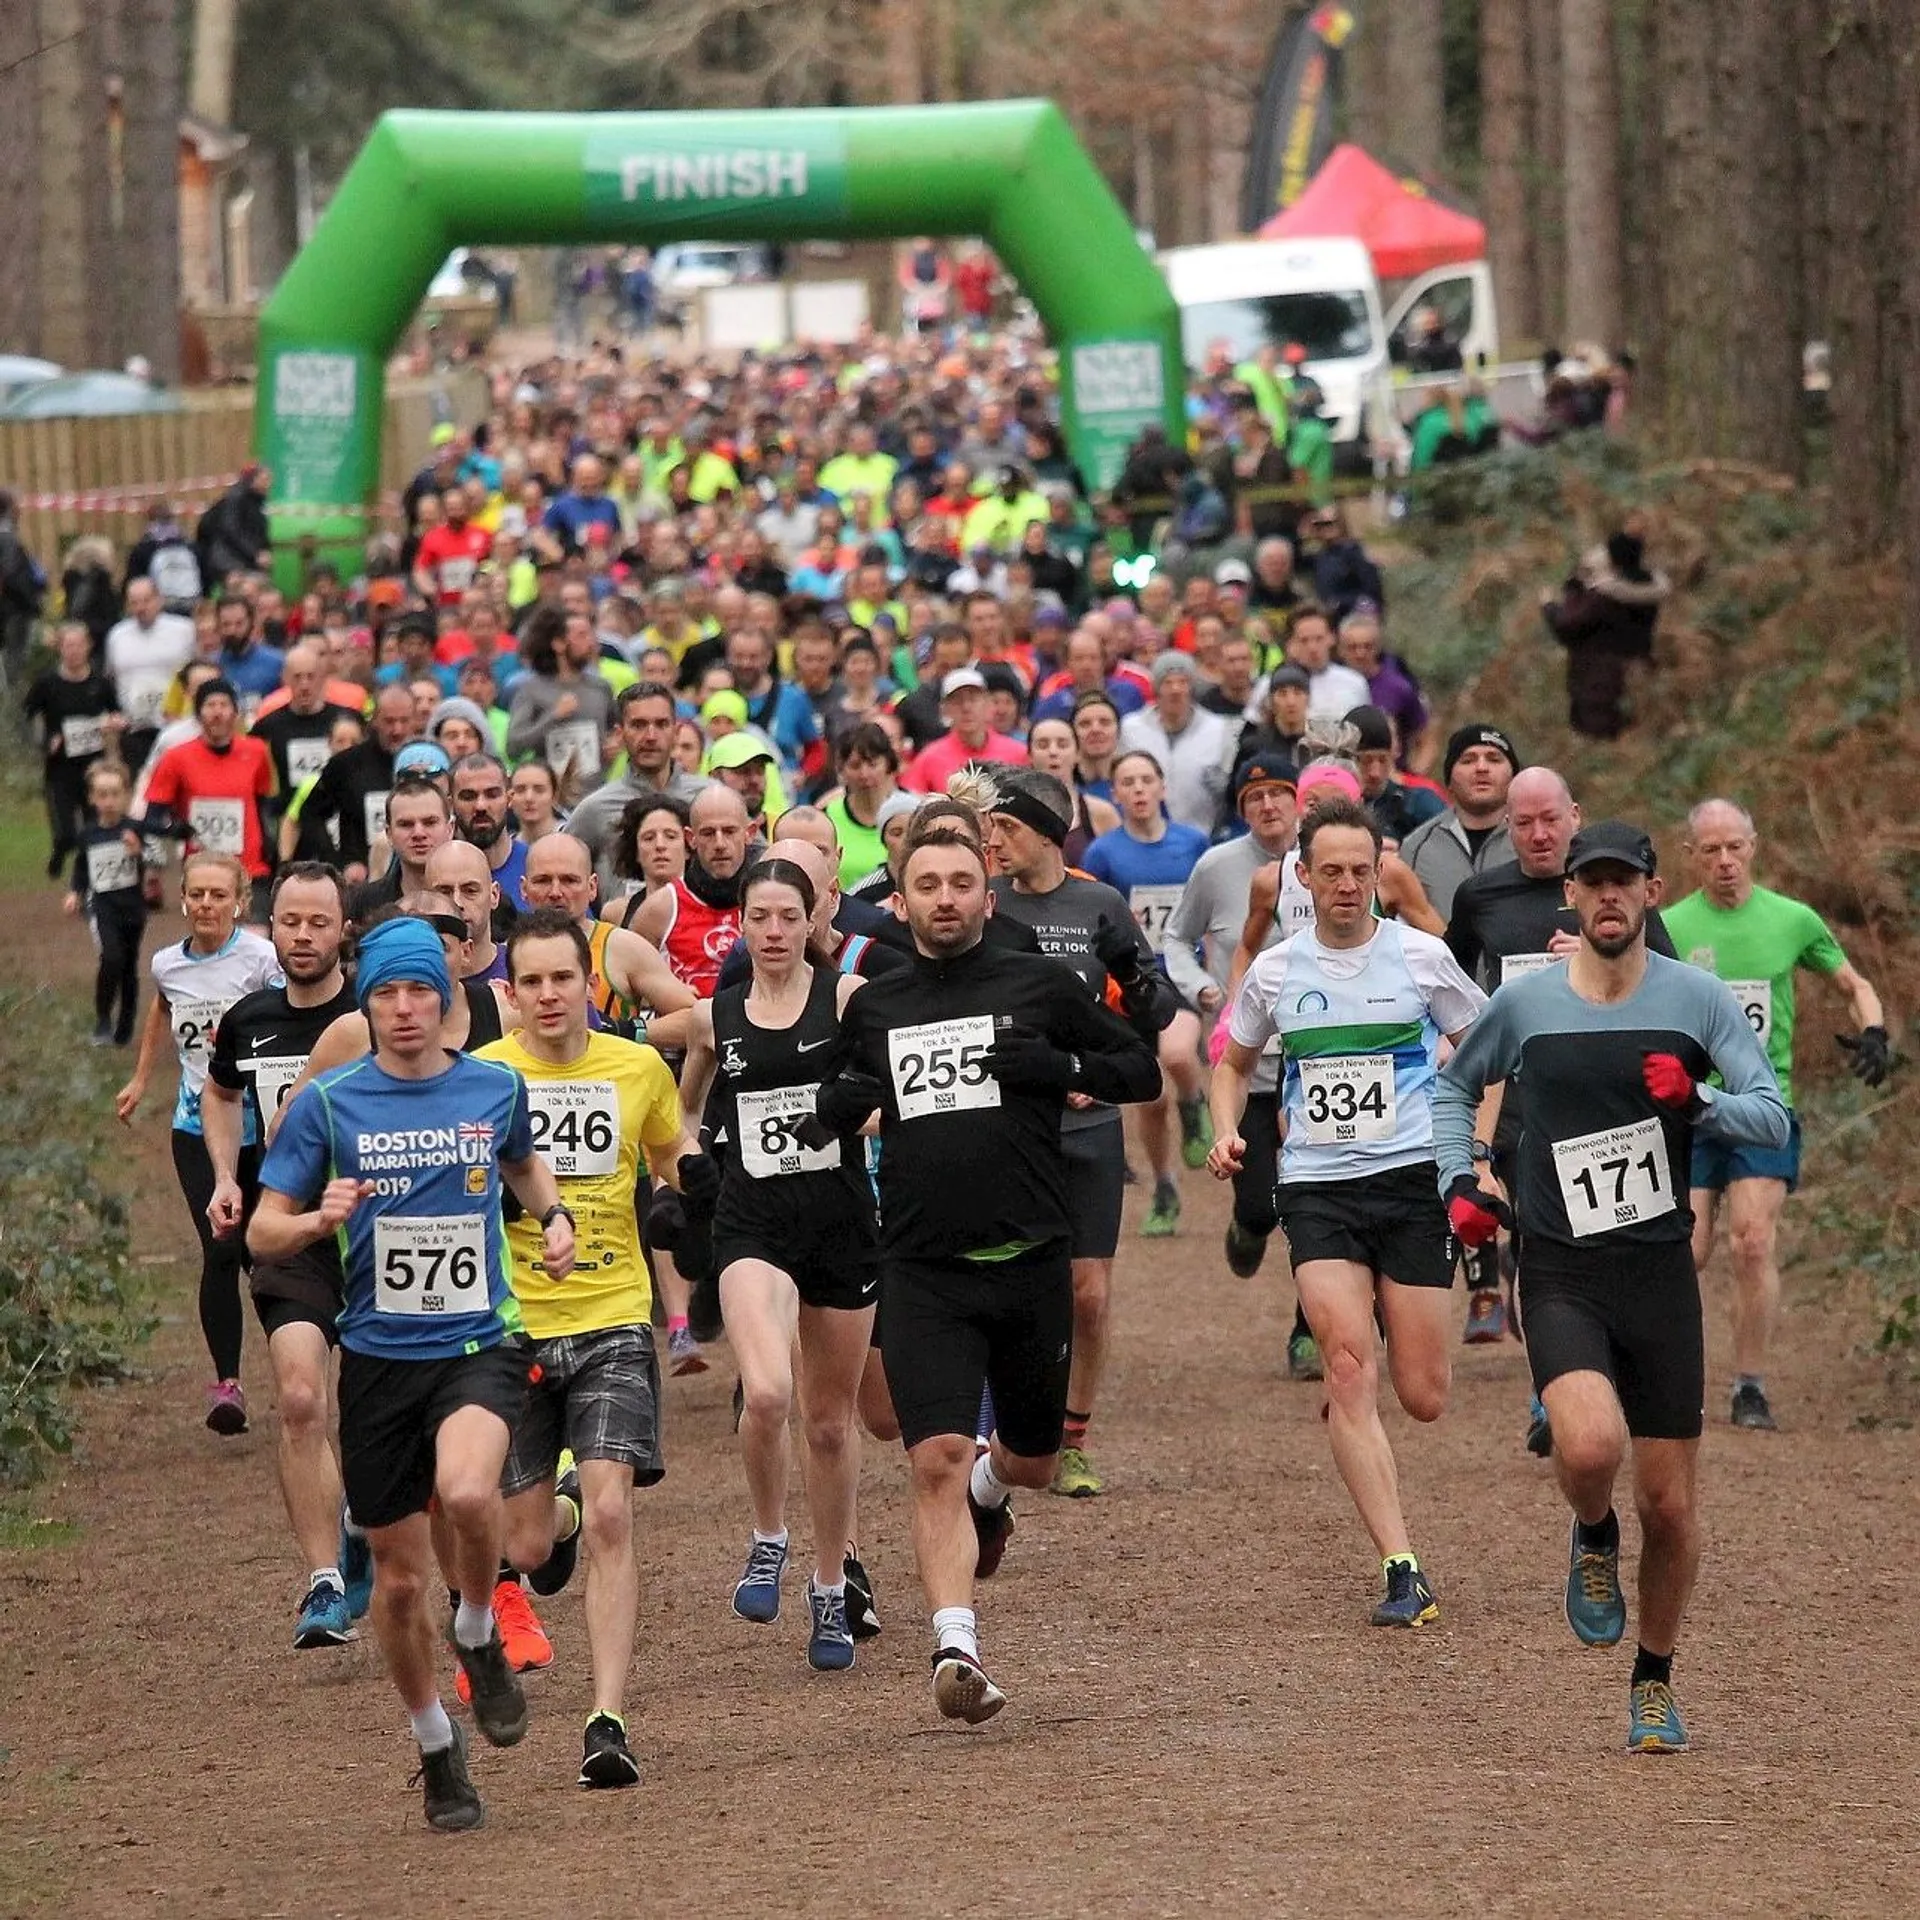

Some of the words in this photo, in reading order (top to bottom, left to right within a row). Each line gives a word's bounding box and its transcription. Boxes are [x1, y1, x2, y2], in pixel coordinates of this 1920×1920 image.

[621, 149, 808, 201] FINISH
[1049, 925, 1089, 936] RUNNER
[1065, 942, 1089, 955] 10K
[894, 1025, 941, 1042] Sherwood
[943, 1024, 965, 1034] New
[967, 1020, 988, 1031] Year
[921, 1039, 939, 1048] 10k
[940, 1037, 948, 1046] &
[950, 1035, 962, 1044] 5k
[259, 1060, 299, 1070] Sherwood
[899, 1044, 989, 1097] 255
[1302, 1060, 1344, 1071] Sherwood
[1346, 1059, 1366, 1068] New
[1368, 1058, 1389, 1067] Year
[1325, 1072, 1341, 1080] 10k
[1351, 1070, 1363, 1079] 5k
[569, 1085, 591, 1095] New
[593, 1085, 612, 1094] Year
[741, 1091, 782, 1105] Sherwood
[784, 1089, 805, 1099] New
[547, 1097, 563, 1106] 10k
[565, 1097, 574, 1106] &
[575, 1097, 587, 1106] 5k
[1308, 1081, 1387, 1123] 334
[528, 1110, 612, 1153] 246
[1558, 1136, 1609, 1155] Sherwood
[1611, 1130, 1635, 1143] New
[1636, 1123, 1656, 1135] Year
[358, 1128, 457, 1154] BOSTON
[359, 1151, 459, 1172] MARATHON
[459, 1141, 493, 1164] UK
[1590, 1151, 1608, 1161] 10k
[1610, 1147, 1618, 1156] &
[1620, 1143, 1633, 1154] 5k
[1572, 1150, 1661, 1210] 171
[382, 1222, 434, 1233] Sherwood
[436, 1222, 459, 1232] New
[461, 1220, 482, 1230] Year
[411, 1235, 429, 1245] 10k
[432, 1235, 440, 1244] &
[442, 1235, 455, 1244] 5k
[384, 1246, 477, 1291] 576
